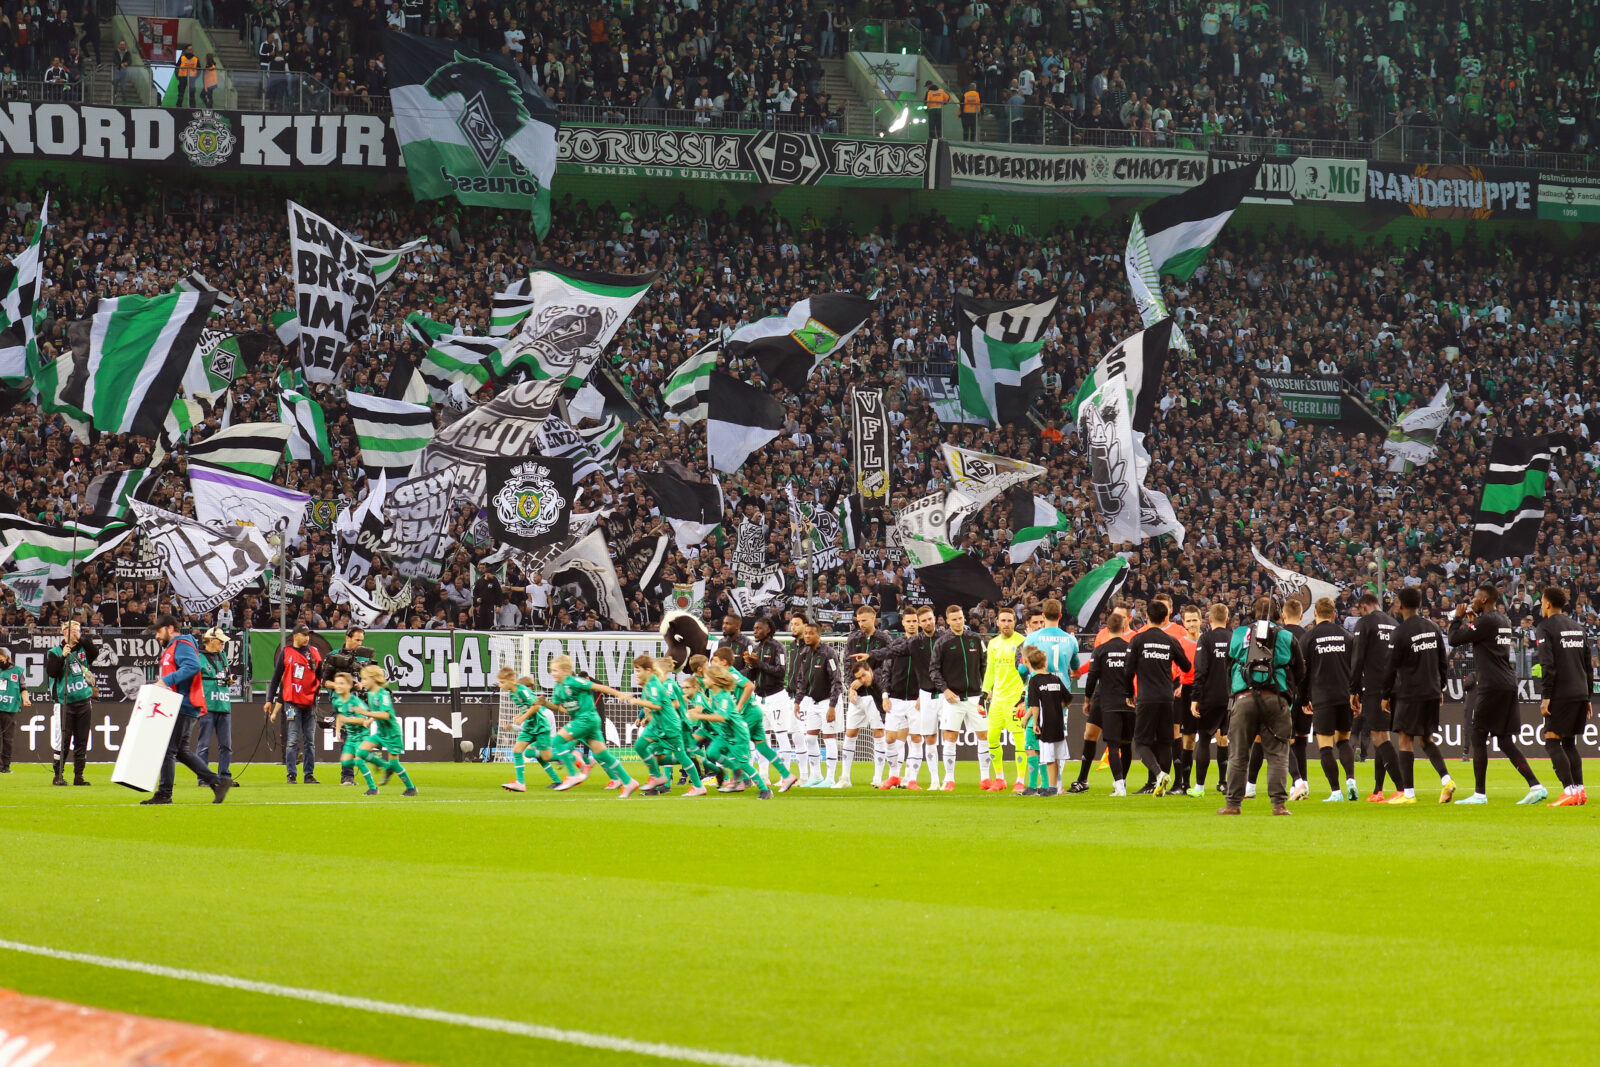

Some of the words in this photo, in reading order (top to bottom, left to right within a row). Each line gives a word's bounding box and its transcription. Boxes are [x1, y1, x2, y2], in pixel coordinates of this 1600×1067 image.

[0, 101, 176, 160] NORD
[557, 129, 740, 172] BORUSSIA
[832, 142, 927, 178] FANS
[584, 165, 637, 176] IMMER
[645, 167, 673, 177] UND
[680, 168, 752, 181] ÜBERALL!
[951, 151, 1088, 182] NIEDERRHEIN
[1112, 156, 1206, 182] CHAOTEN
[1367, 168, 1532, 211] RANDGRUPPE
[856, 391, 882, 467] VFL
[1315, 643, 1346, 655] indeed
[1560, 637, 1584, 649] indeed
[1142, 649, 1170, 660] indeed
[67, 681, 88, 694] HOS
[210, 691, 230, 702] HOS
[772, 709, 781, 720] 17
